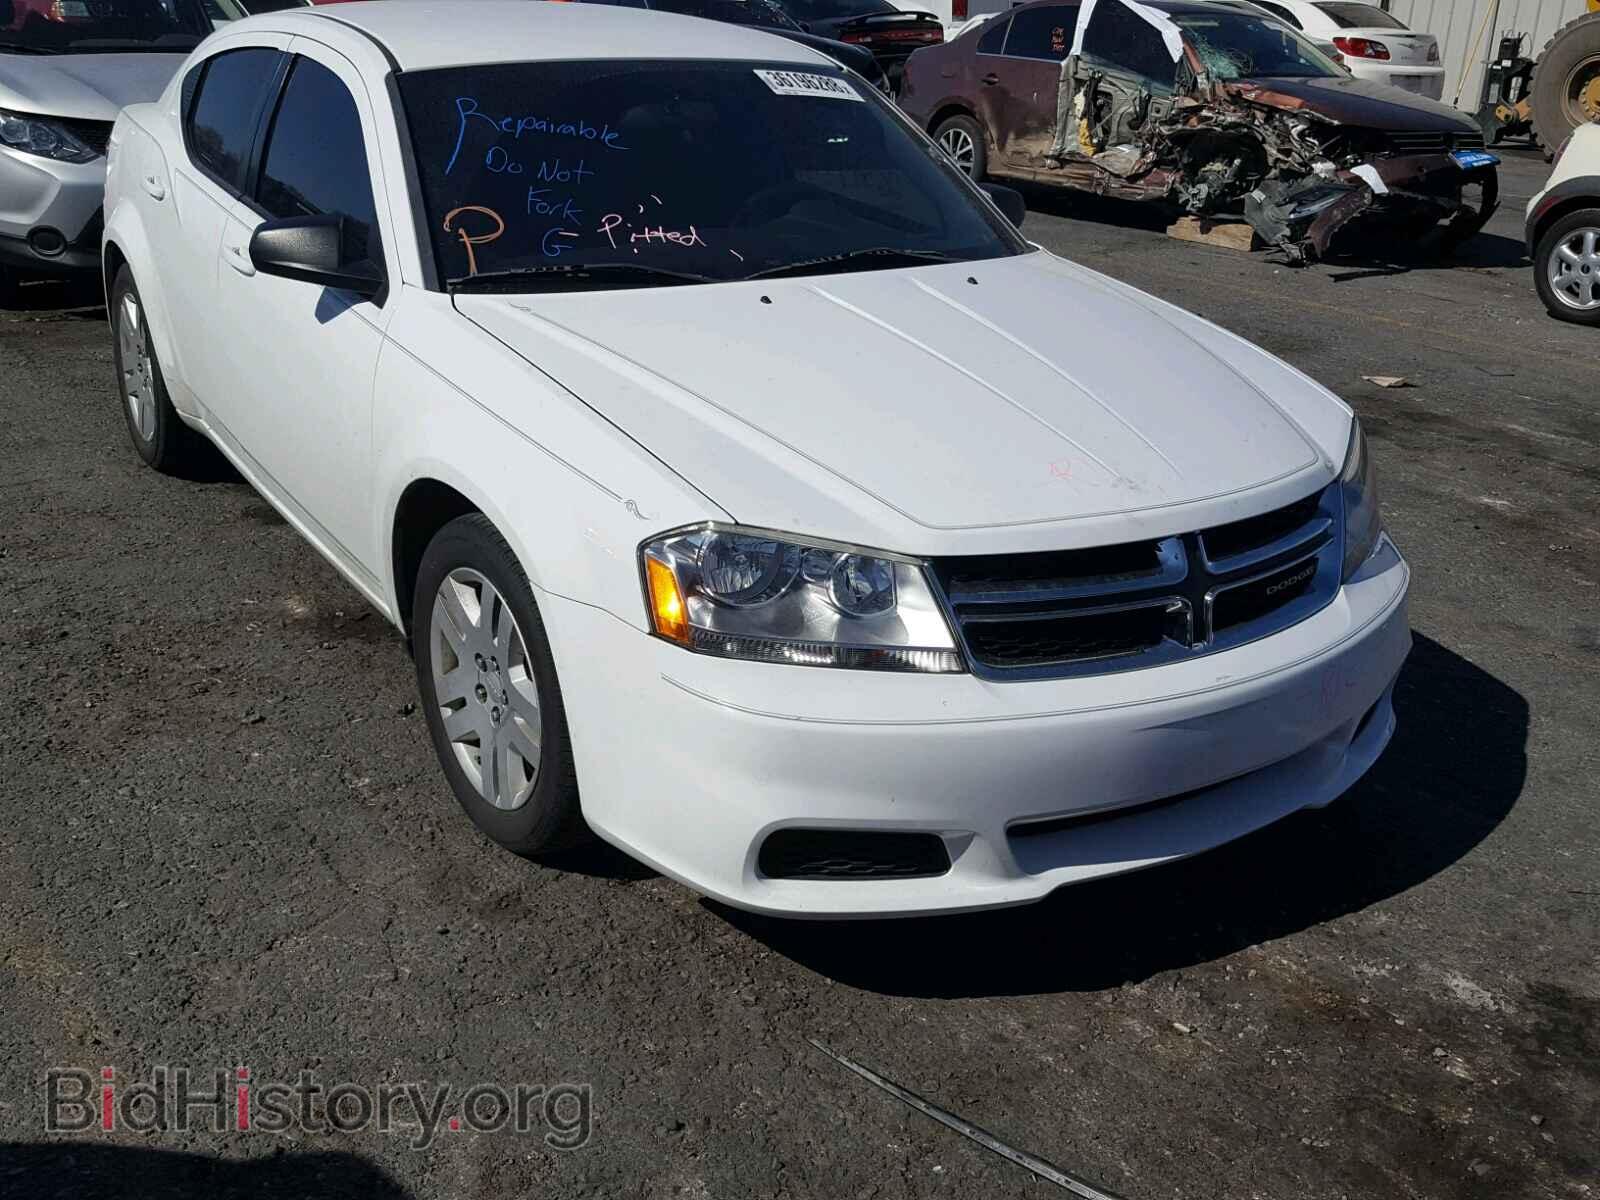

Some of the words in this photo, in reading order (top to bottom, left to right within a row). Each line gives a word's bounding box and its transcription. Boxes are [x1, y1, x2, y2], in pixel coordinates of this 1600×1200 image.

[445, 97, 632, 175] Repairable
[485, 146, 523, 173] Do
[537, 159, 595, 185] Not
[527, 186, 584, 226] Fork
